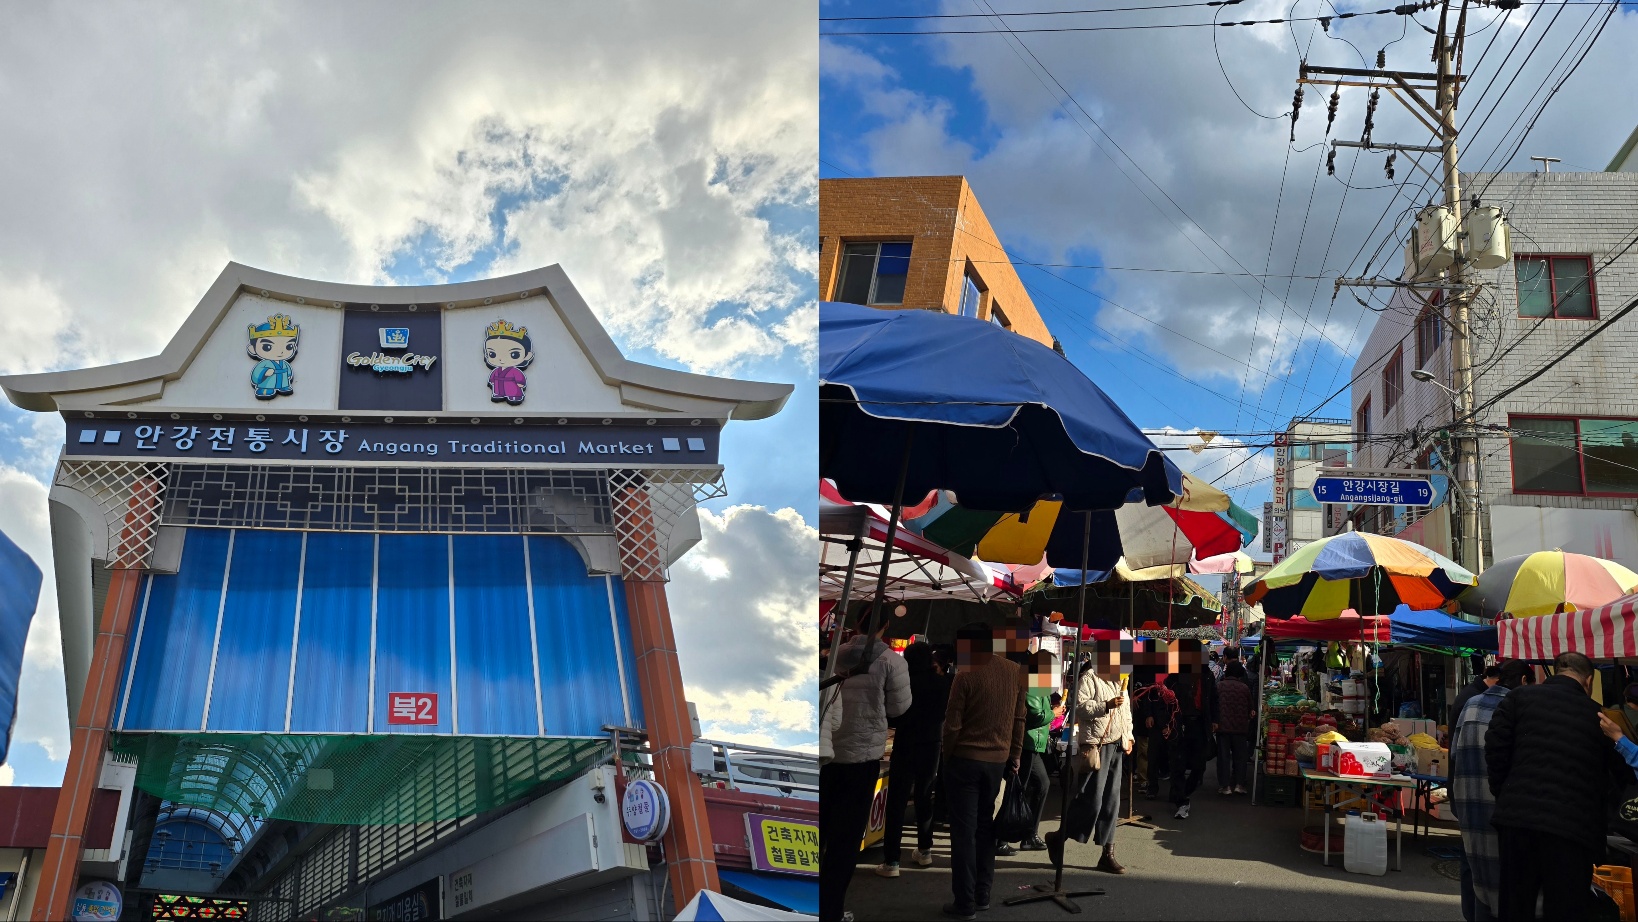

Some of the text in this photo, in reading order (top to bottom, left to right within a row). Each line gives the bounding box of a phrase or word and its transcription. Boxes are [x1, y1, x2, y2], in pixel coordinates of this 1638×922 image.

[373, 364, 413, 372] Gyeongju
[134, 425, 350, 453] 안강전통시장
[358, 439, 654, 455] Angang Traditional Market
[1317, 485, 1327, 494] 15
[1343, 480, 1400, 494] 안강시장길
[1417, 488, 1429, 497] 19
[393, 696, 433, 721] 북2
[767, 825, 819, 847] 건축자재
[771, 846, 819, 867] 철물일체
[396, 892, 420, 920] 미용실
